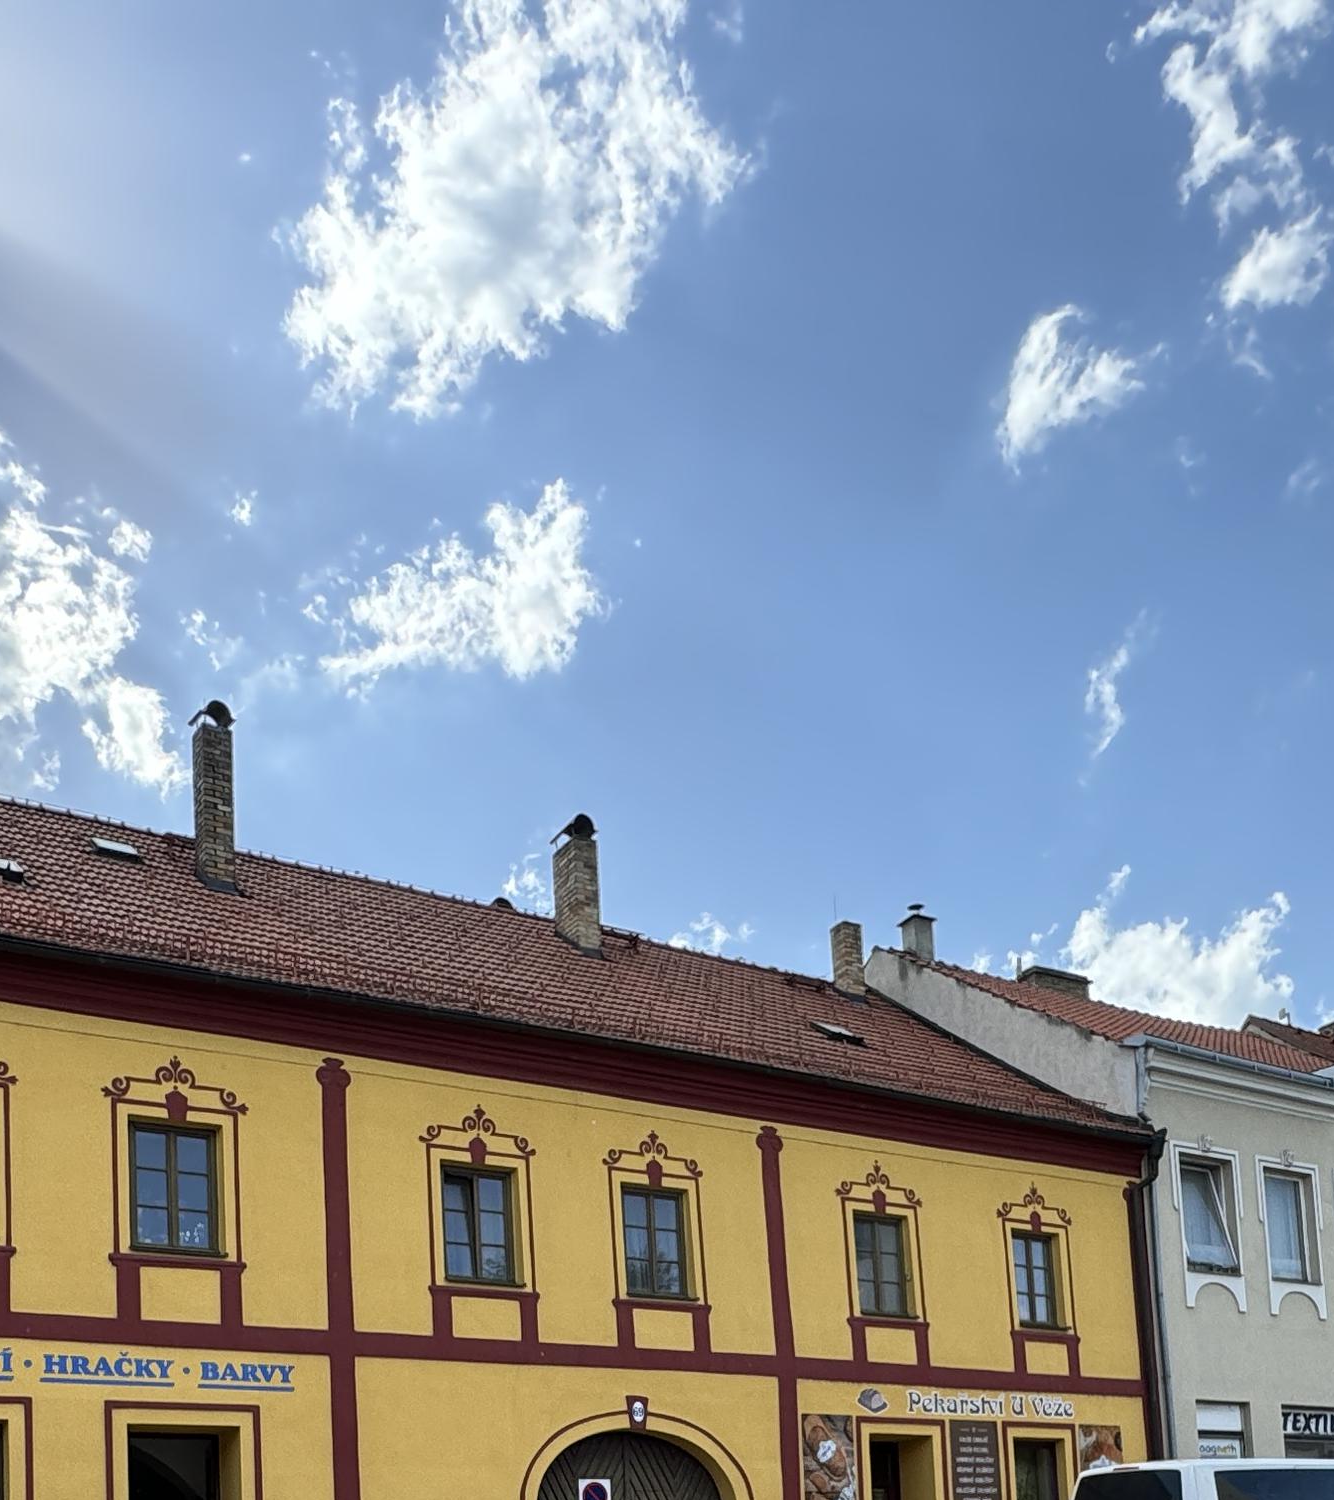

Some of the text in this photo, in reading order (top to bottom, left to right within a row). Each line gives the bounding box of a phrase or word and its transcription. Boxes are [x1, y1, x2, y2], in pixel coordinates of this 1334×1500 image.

[43, 1352, 174, 1378] HRAČKY
[200, 1361, 295, 1383] BARVY
[632, 1406, 644, 1417] 69
[907, 1390, 1075, 1418] Pekařství U Věže
